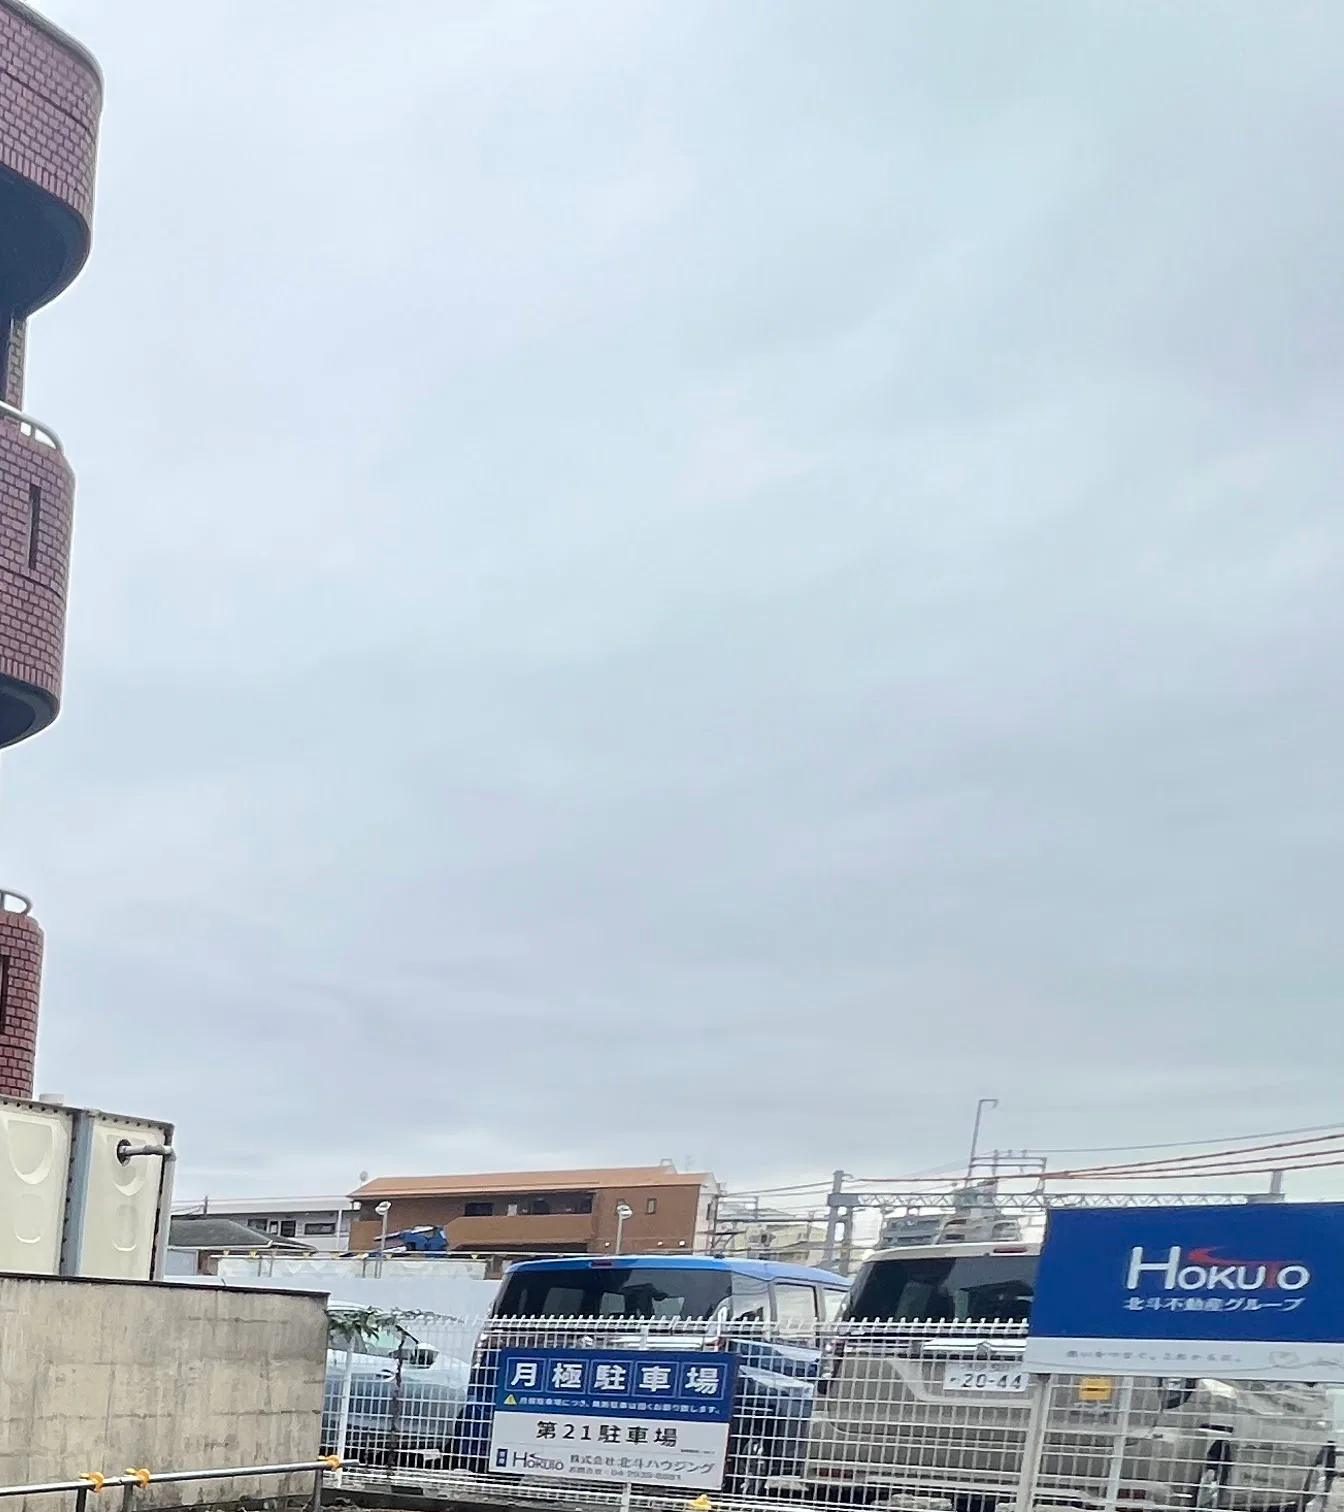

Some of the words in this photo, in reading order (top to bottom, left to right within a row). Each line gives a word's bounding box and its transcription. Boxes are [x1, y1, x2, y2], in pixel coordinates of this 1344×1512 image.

[1123, 1297, 1306, 1312] 北斗不動産グループ
[511, 1362, 720, 1394] 月極駐車場
[536, 1420, 678, 1447] 第21駐車場
